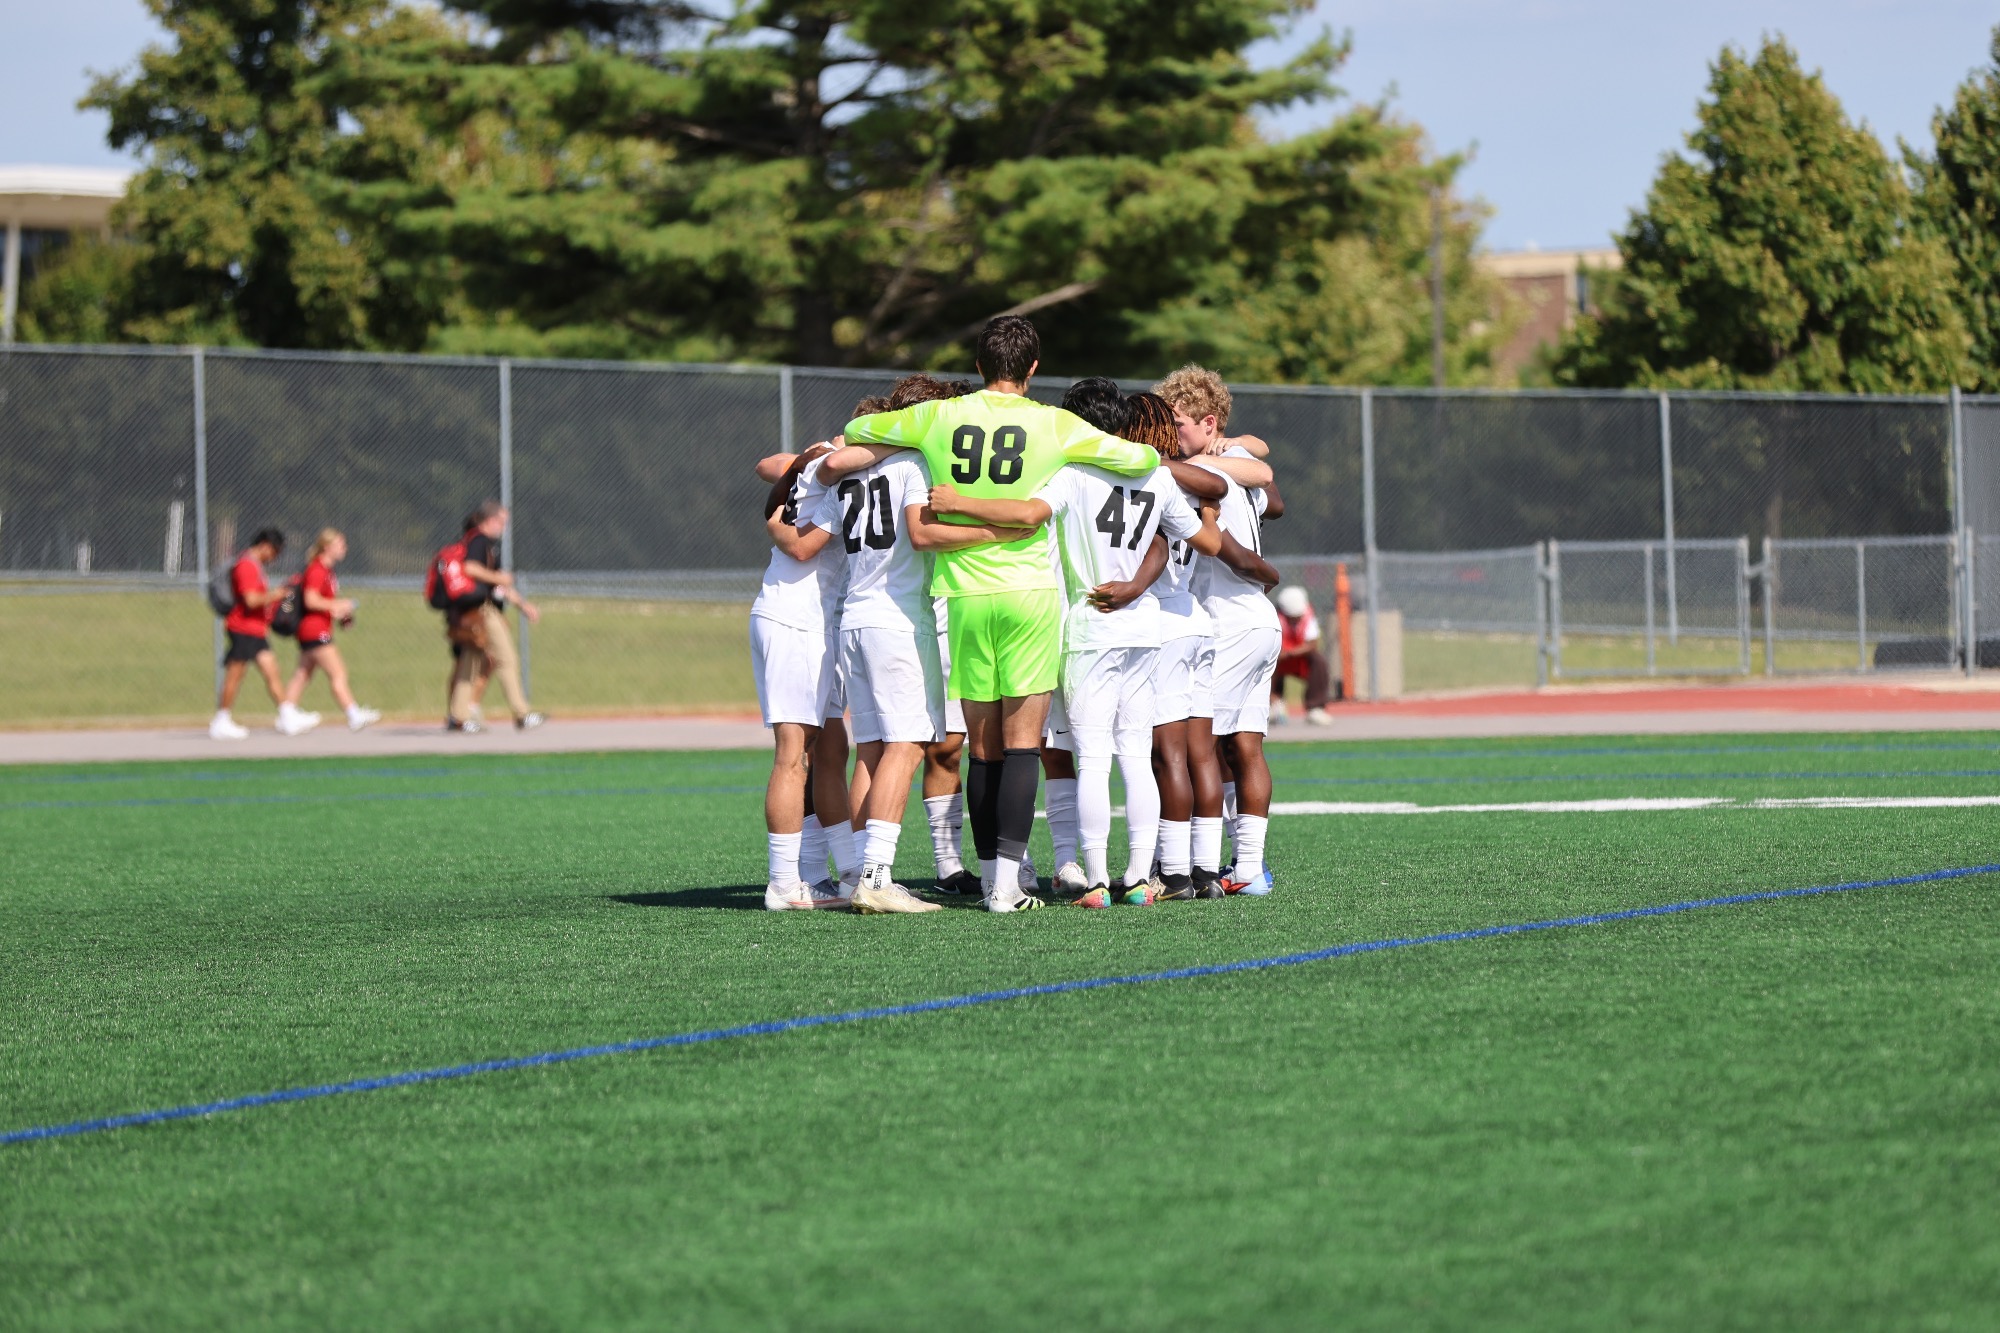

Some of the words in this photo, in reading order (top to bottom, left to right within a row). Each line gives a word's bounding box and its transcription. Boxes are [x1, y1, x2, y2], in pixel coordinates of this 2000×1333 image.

[951, 424, 1027, 485] 98
[837, 475, 897, 555] 20
[1095, 485, 1156, 551] 47
